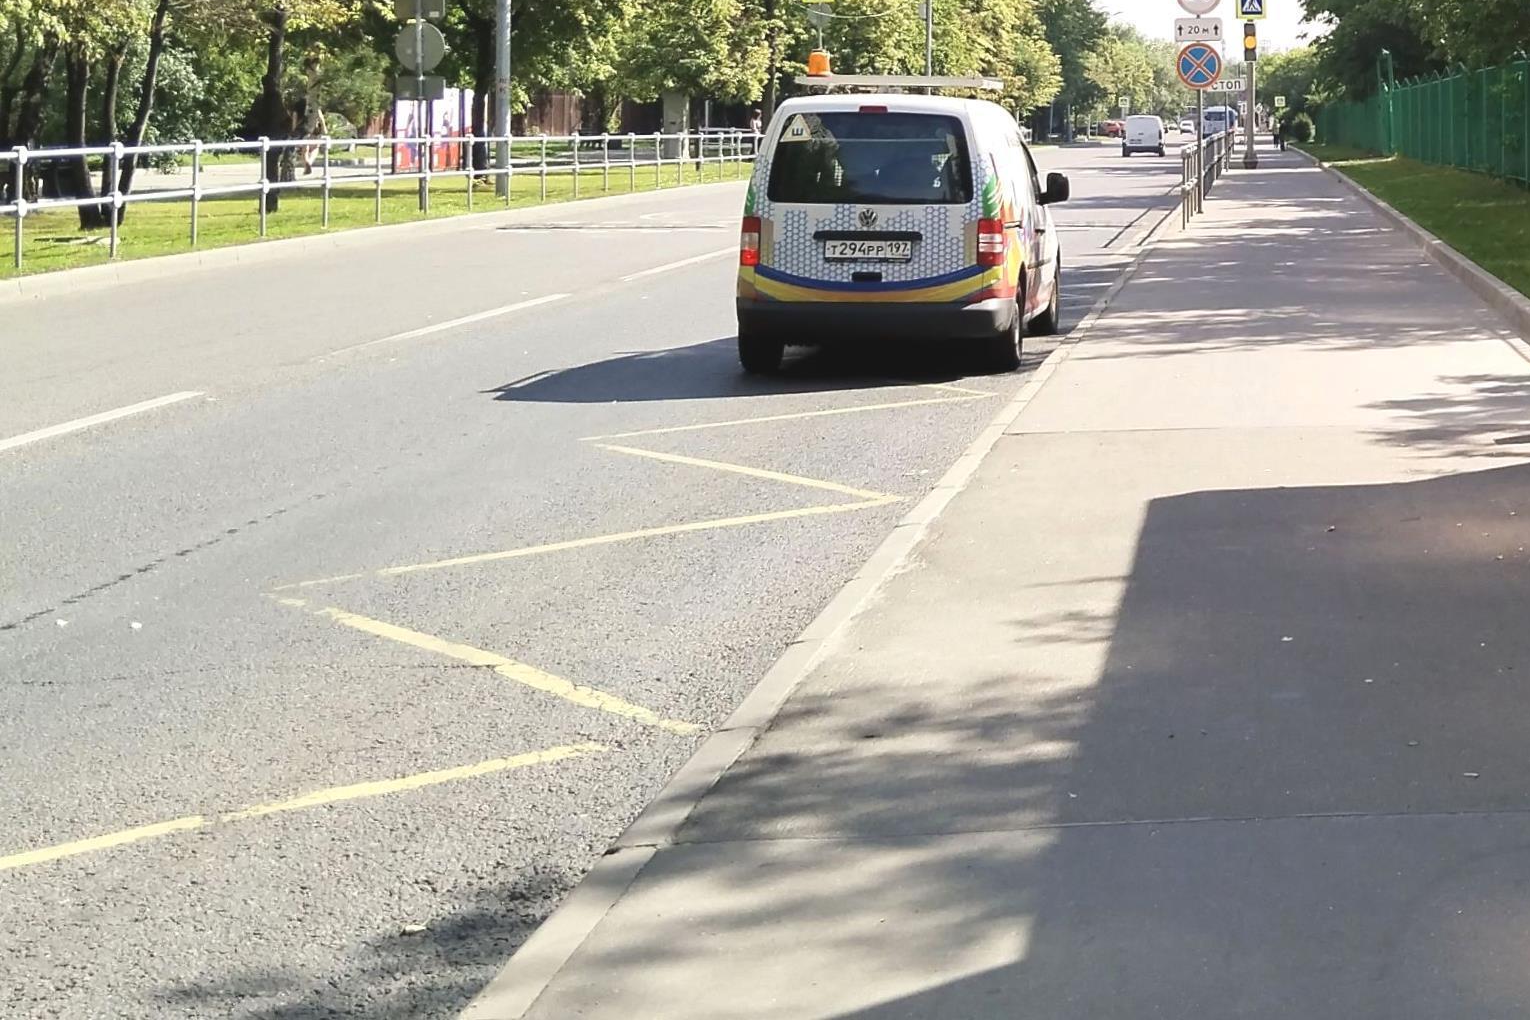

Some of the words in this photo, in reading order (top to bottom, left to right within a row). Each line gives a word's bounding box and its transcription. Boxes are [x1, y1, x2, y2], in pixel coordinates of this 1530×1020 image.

[1188, 25, 1200, 34] 20
[1212, 80, 1241, 90] СТОП
[792, 127, 803, 136] Ш
[888, 242, 907, 253] 197
